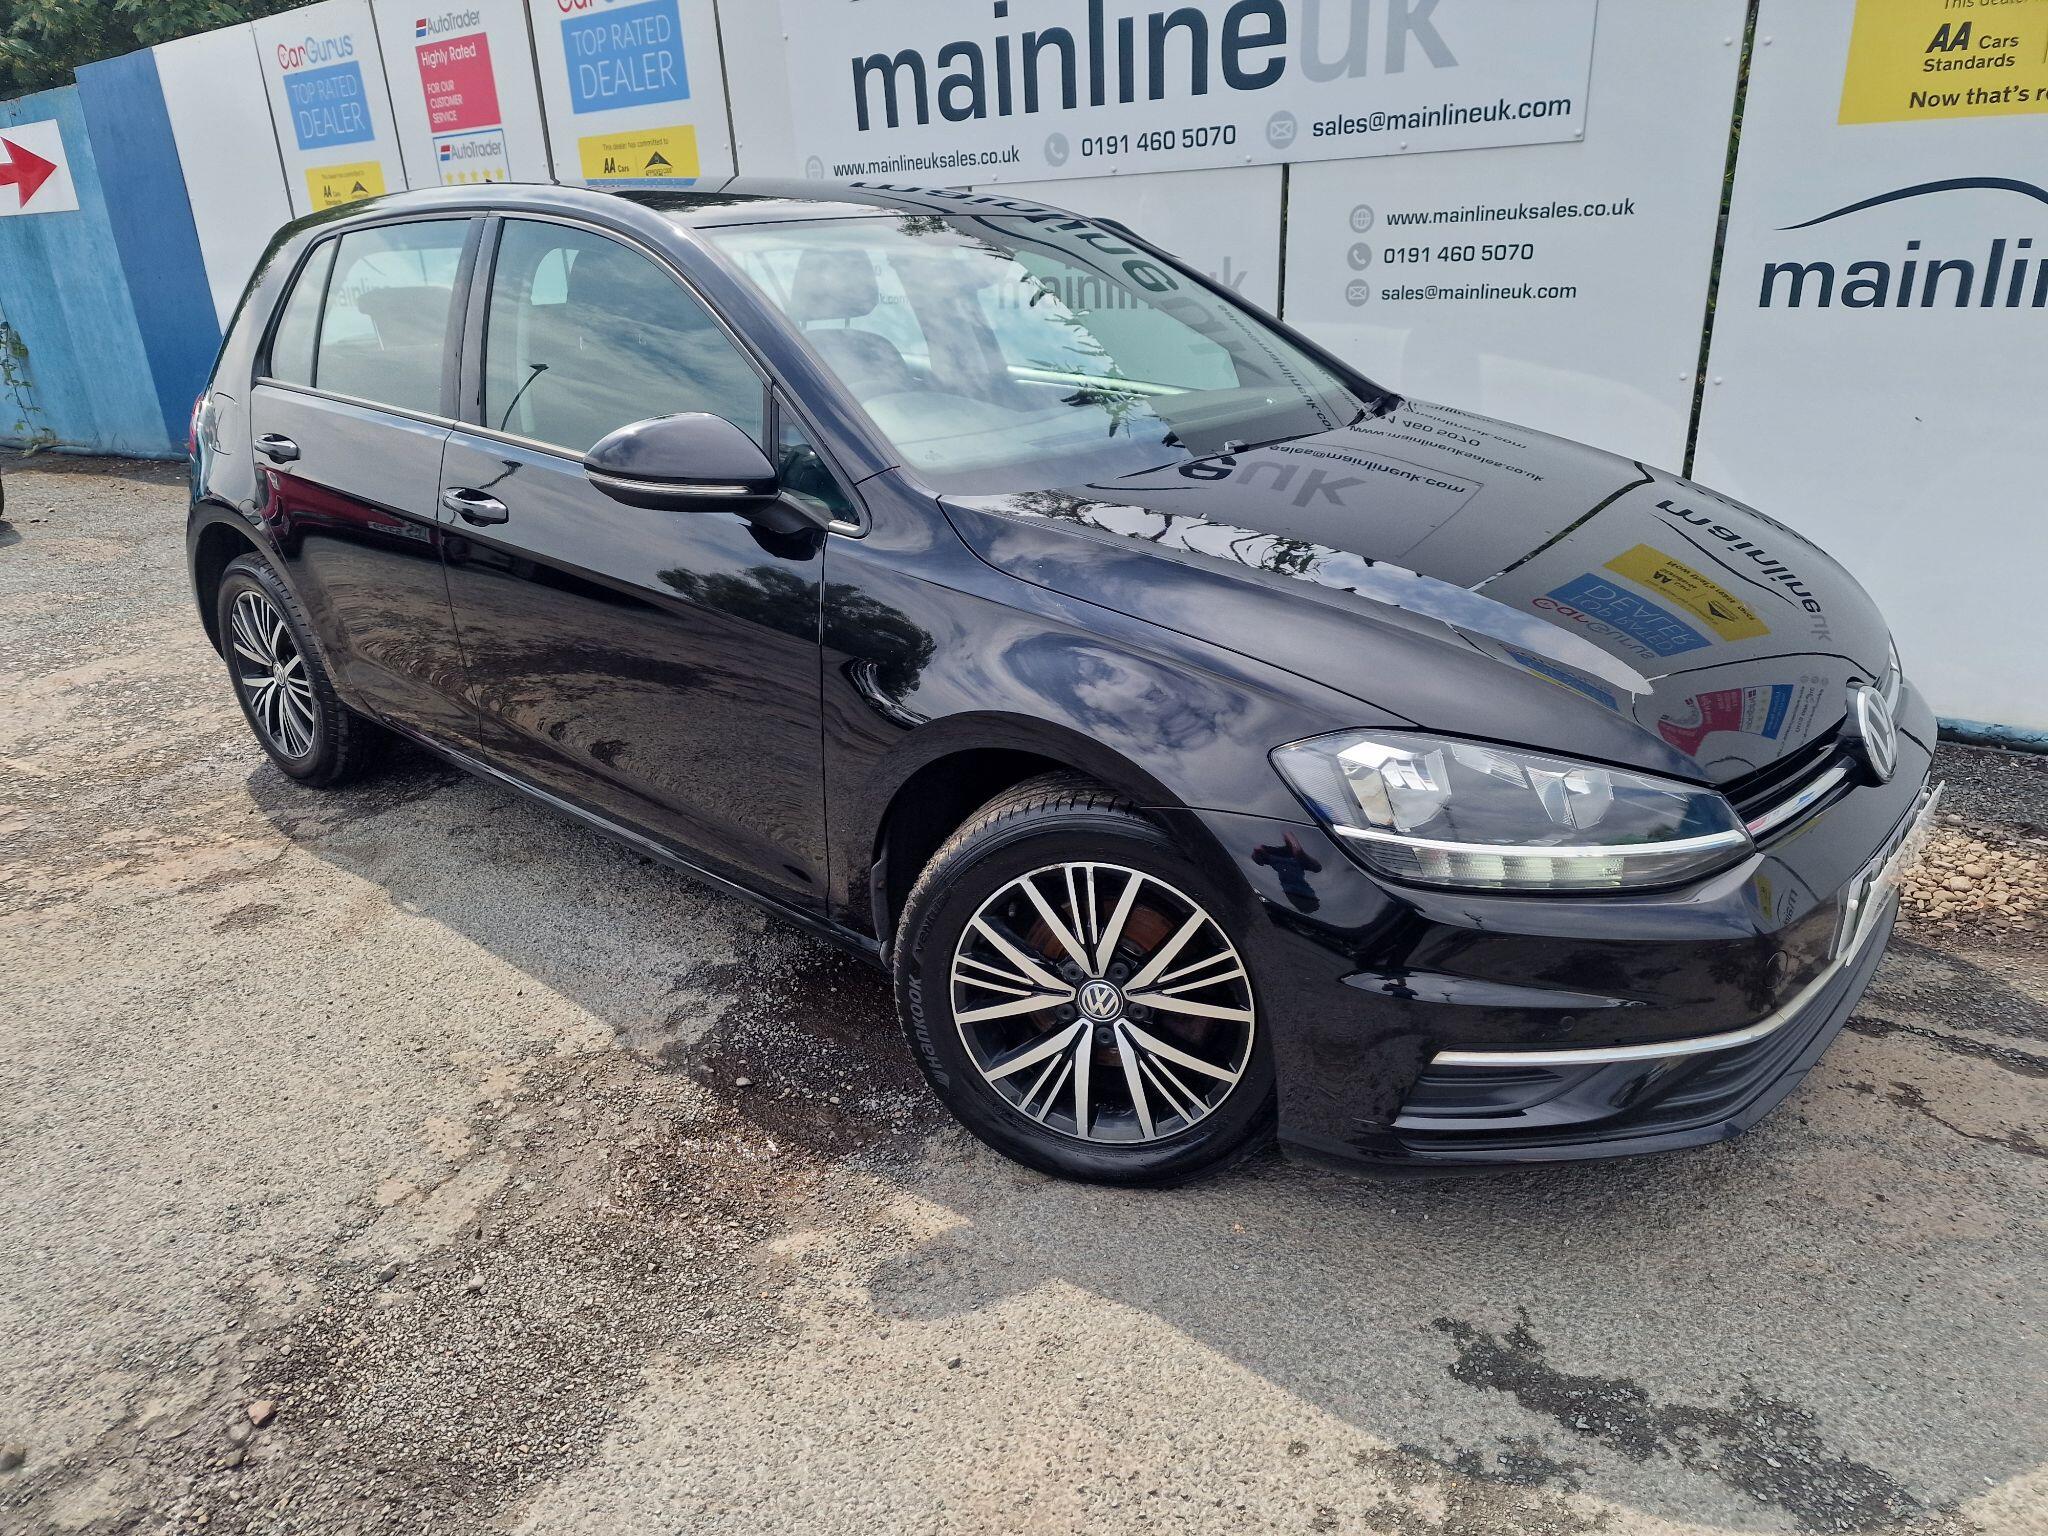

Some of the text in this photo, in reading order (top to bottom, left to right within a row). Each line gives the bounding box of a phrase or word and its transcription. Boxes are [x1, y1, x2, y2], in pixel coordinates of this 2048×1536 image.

[571, 14, 671, 57] TOP RATED
[1925, 21, 2019, 53] AA Cars
[277, 34, 354, 70] CarGurus
[421, 42, 477, 68] Highly Rated
[1923, 53, 2016, 72] Standards
[427, 80, 455, 94] FOR OUR
[579, 50, 678, 99] DEALER
[291, 74, 358, 104] TOP RATED
[430, 94, 464, 109] CUSTOMER
[1909, 91, 1961, 108] Now
[1967, 85, 2030, 105] that's
[299, 102, 366, 139] DEALER
[432, 110, 458, 124] SERVICE
[1312, 97, 1572, 137] sales@mainlineuk.com
[451, 140, 503, 160] AutoTrader
[833, 125, 1237, 177] www.mainlineuksales.co.uk 0191 460 5070
[604, 157, 630, 174] AA Cars
[1386, 198, 1636, 226] www.mainlineuksales.co.uk
[1383, 243, 1534, 264] 0191 460 5070
[1381, 282, 1578, 302] sales@mainlineuk.com
